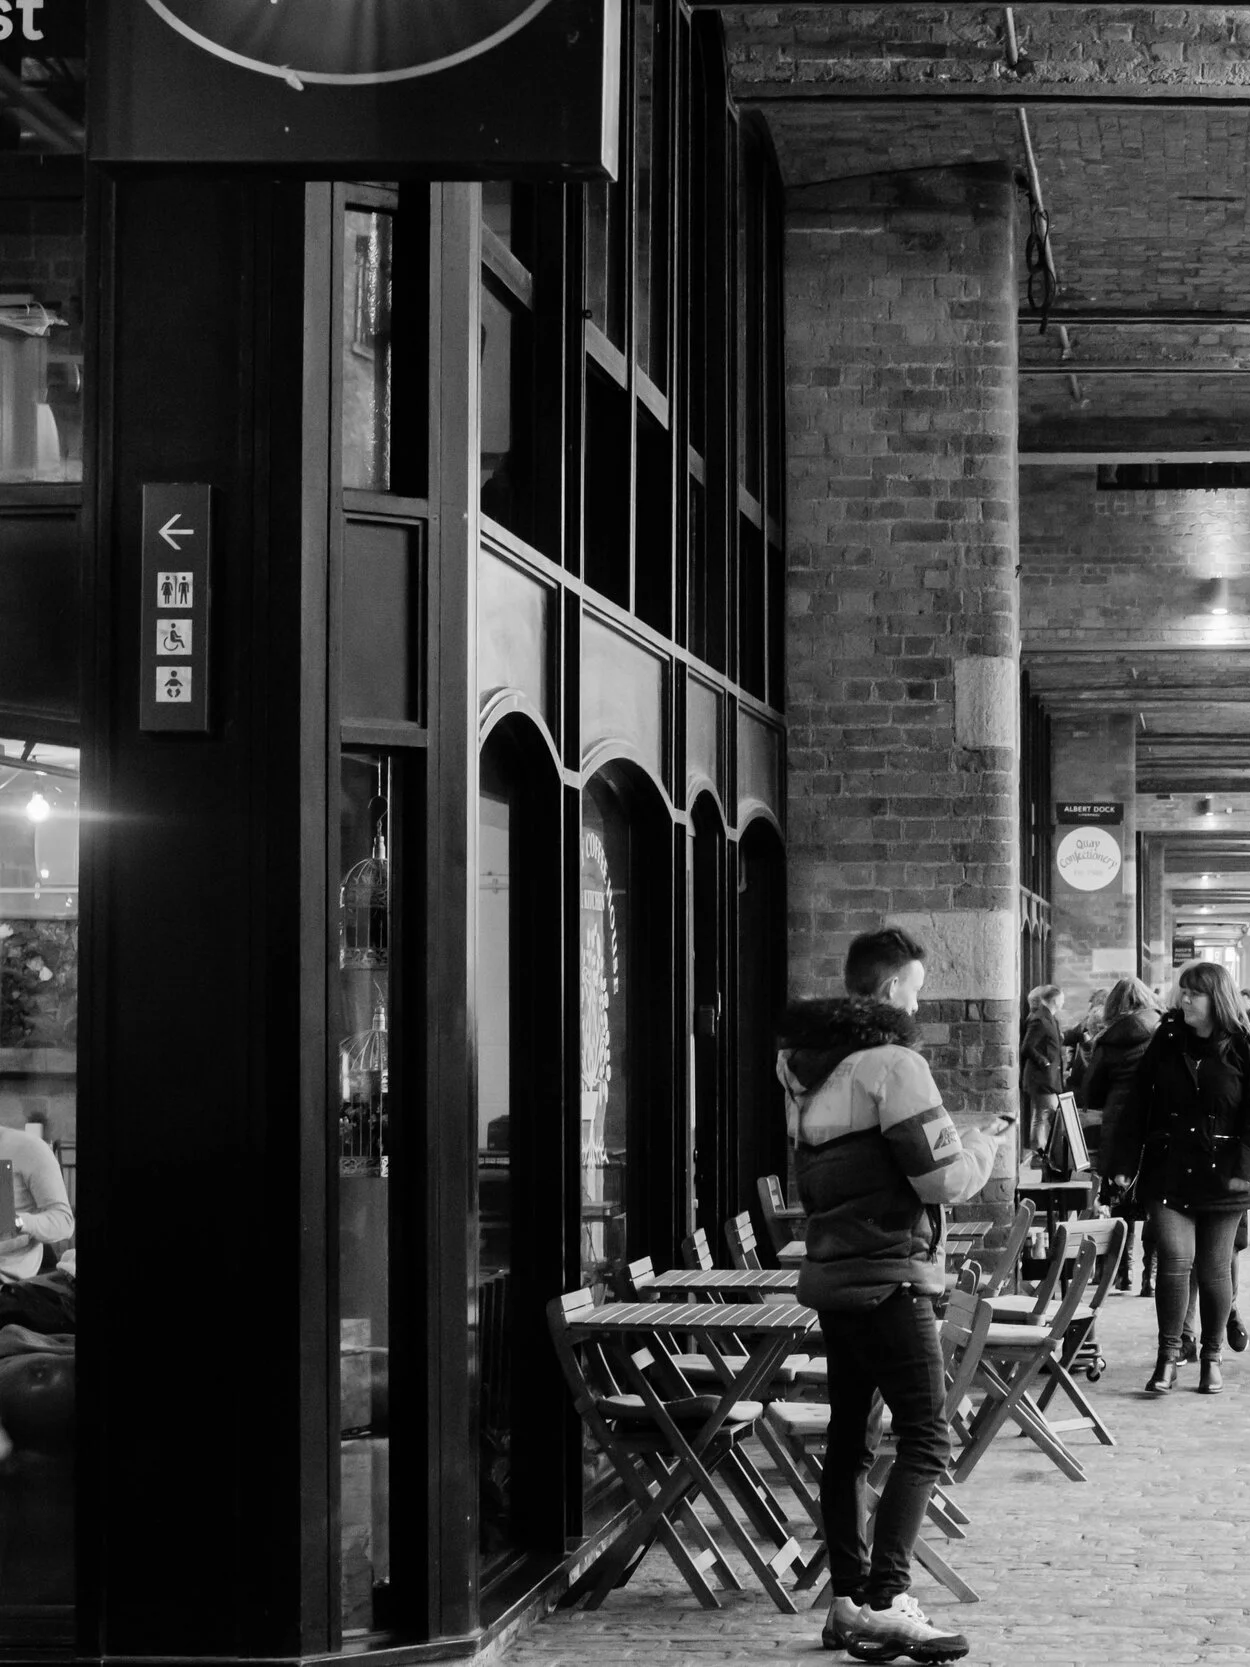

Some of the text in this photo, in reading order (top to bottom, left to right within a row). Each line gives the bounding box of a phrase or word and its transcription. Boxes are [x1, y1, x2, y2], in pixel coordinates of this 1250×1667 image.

[1076, 839, 1101, 851] Quay
[586, 832, 608, 884] COFFEE
[1060, 849, 1117, 869] Confectionery
